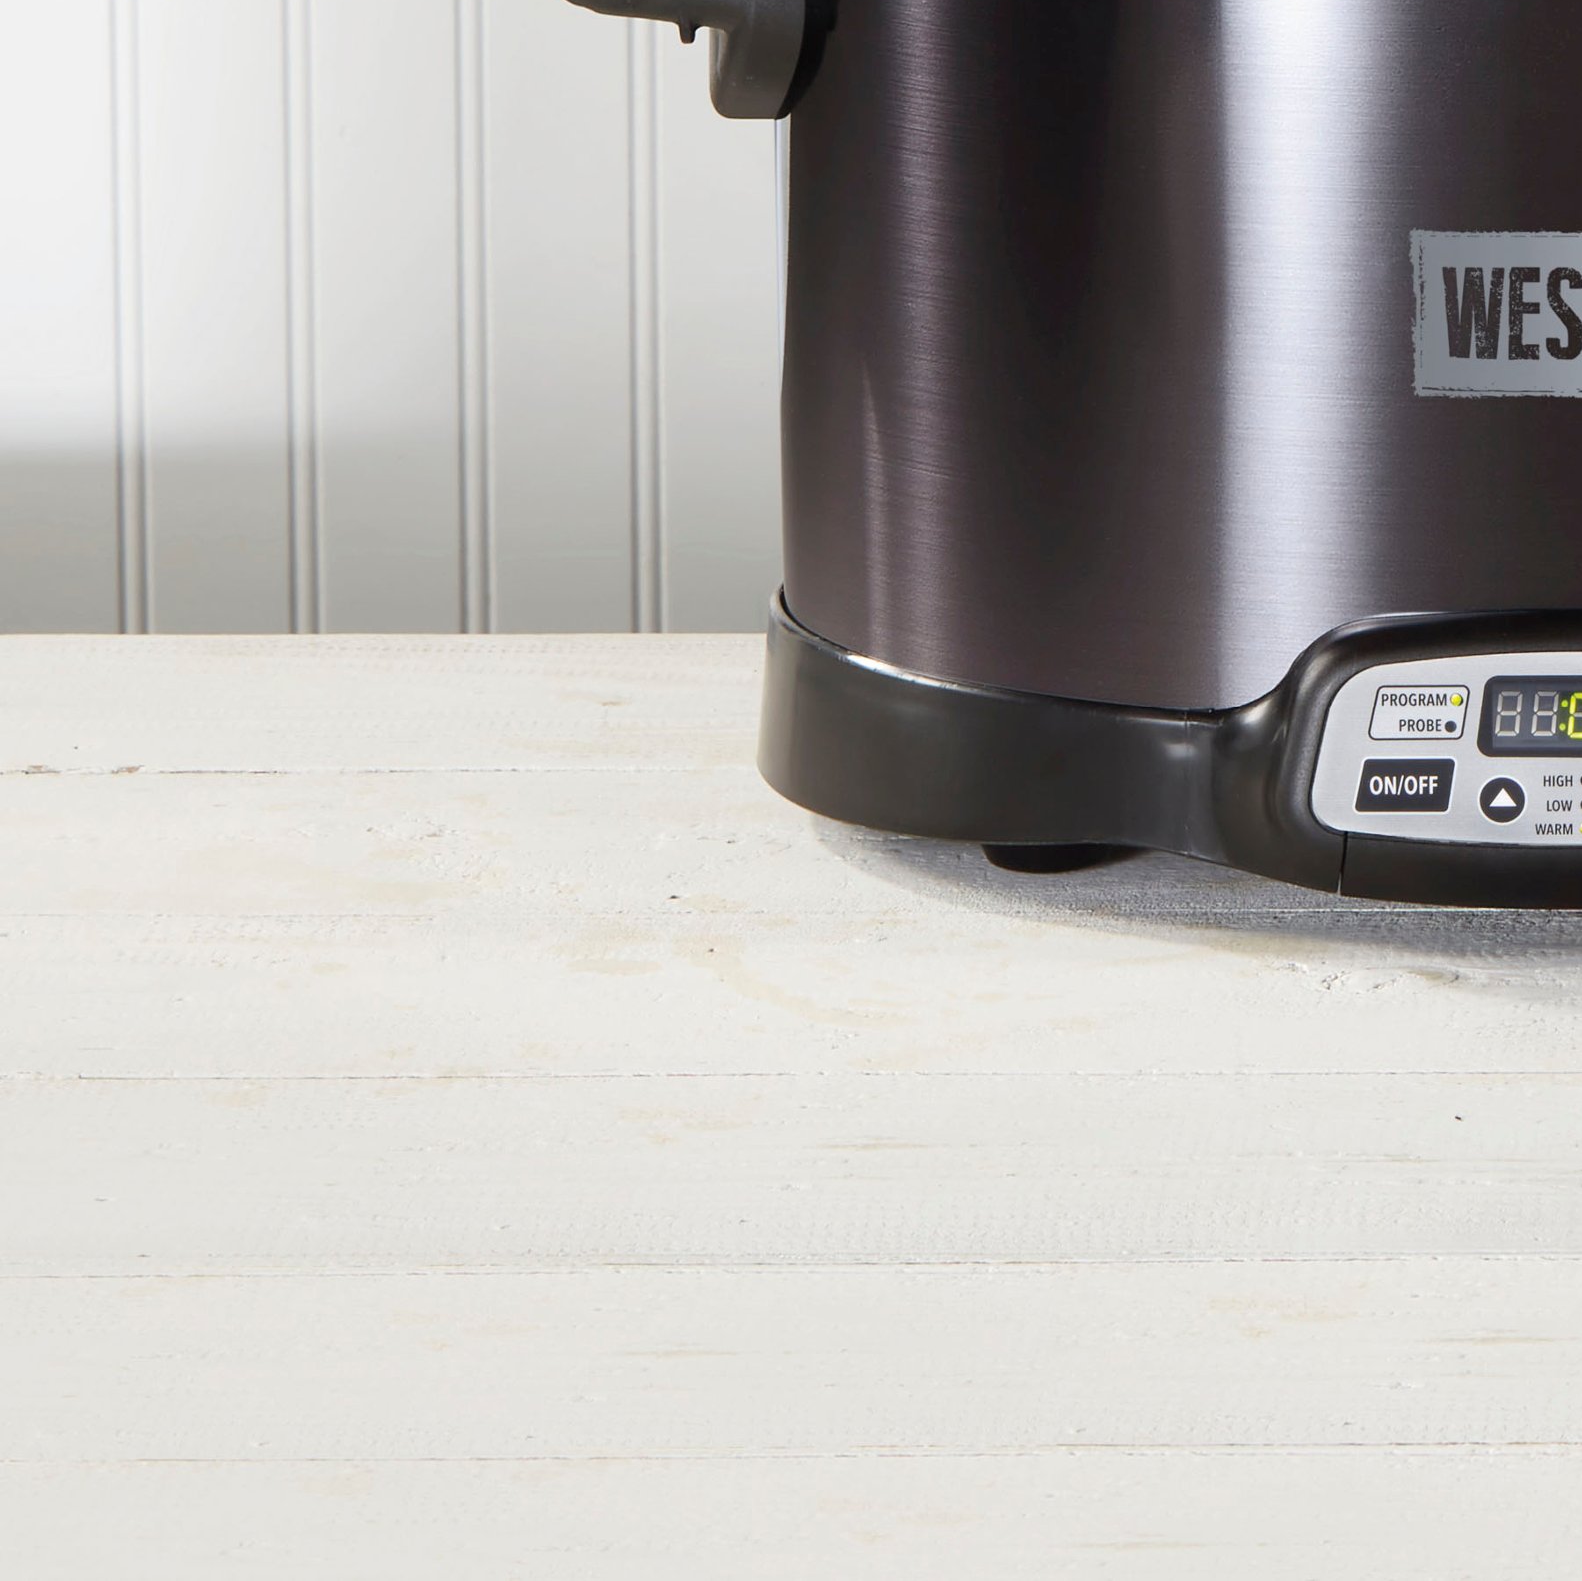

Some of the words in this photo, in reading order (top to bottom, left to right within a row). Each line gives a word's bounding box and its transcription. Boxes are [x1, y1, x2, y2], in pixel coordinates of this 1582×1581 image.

[1381, 693, 1448, 706] PROGRAM
[1399, 719, 1442, 732] PROBE
[1369, 775, 1438, 795] ON/OFF
[1543, 775, 1573, 787] HIGH
[1546, 800, 1573, 812] LOW
[1535, 823, 1573, 835] WARM
